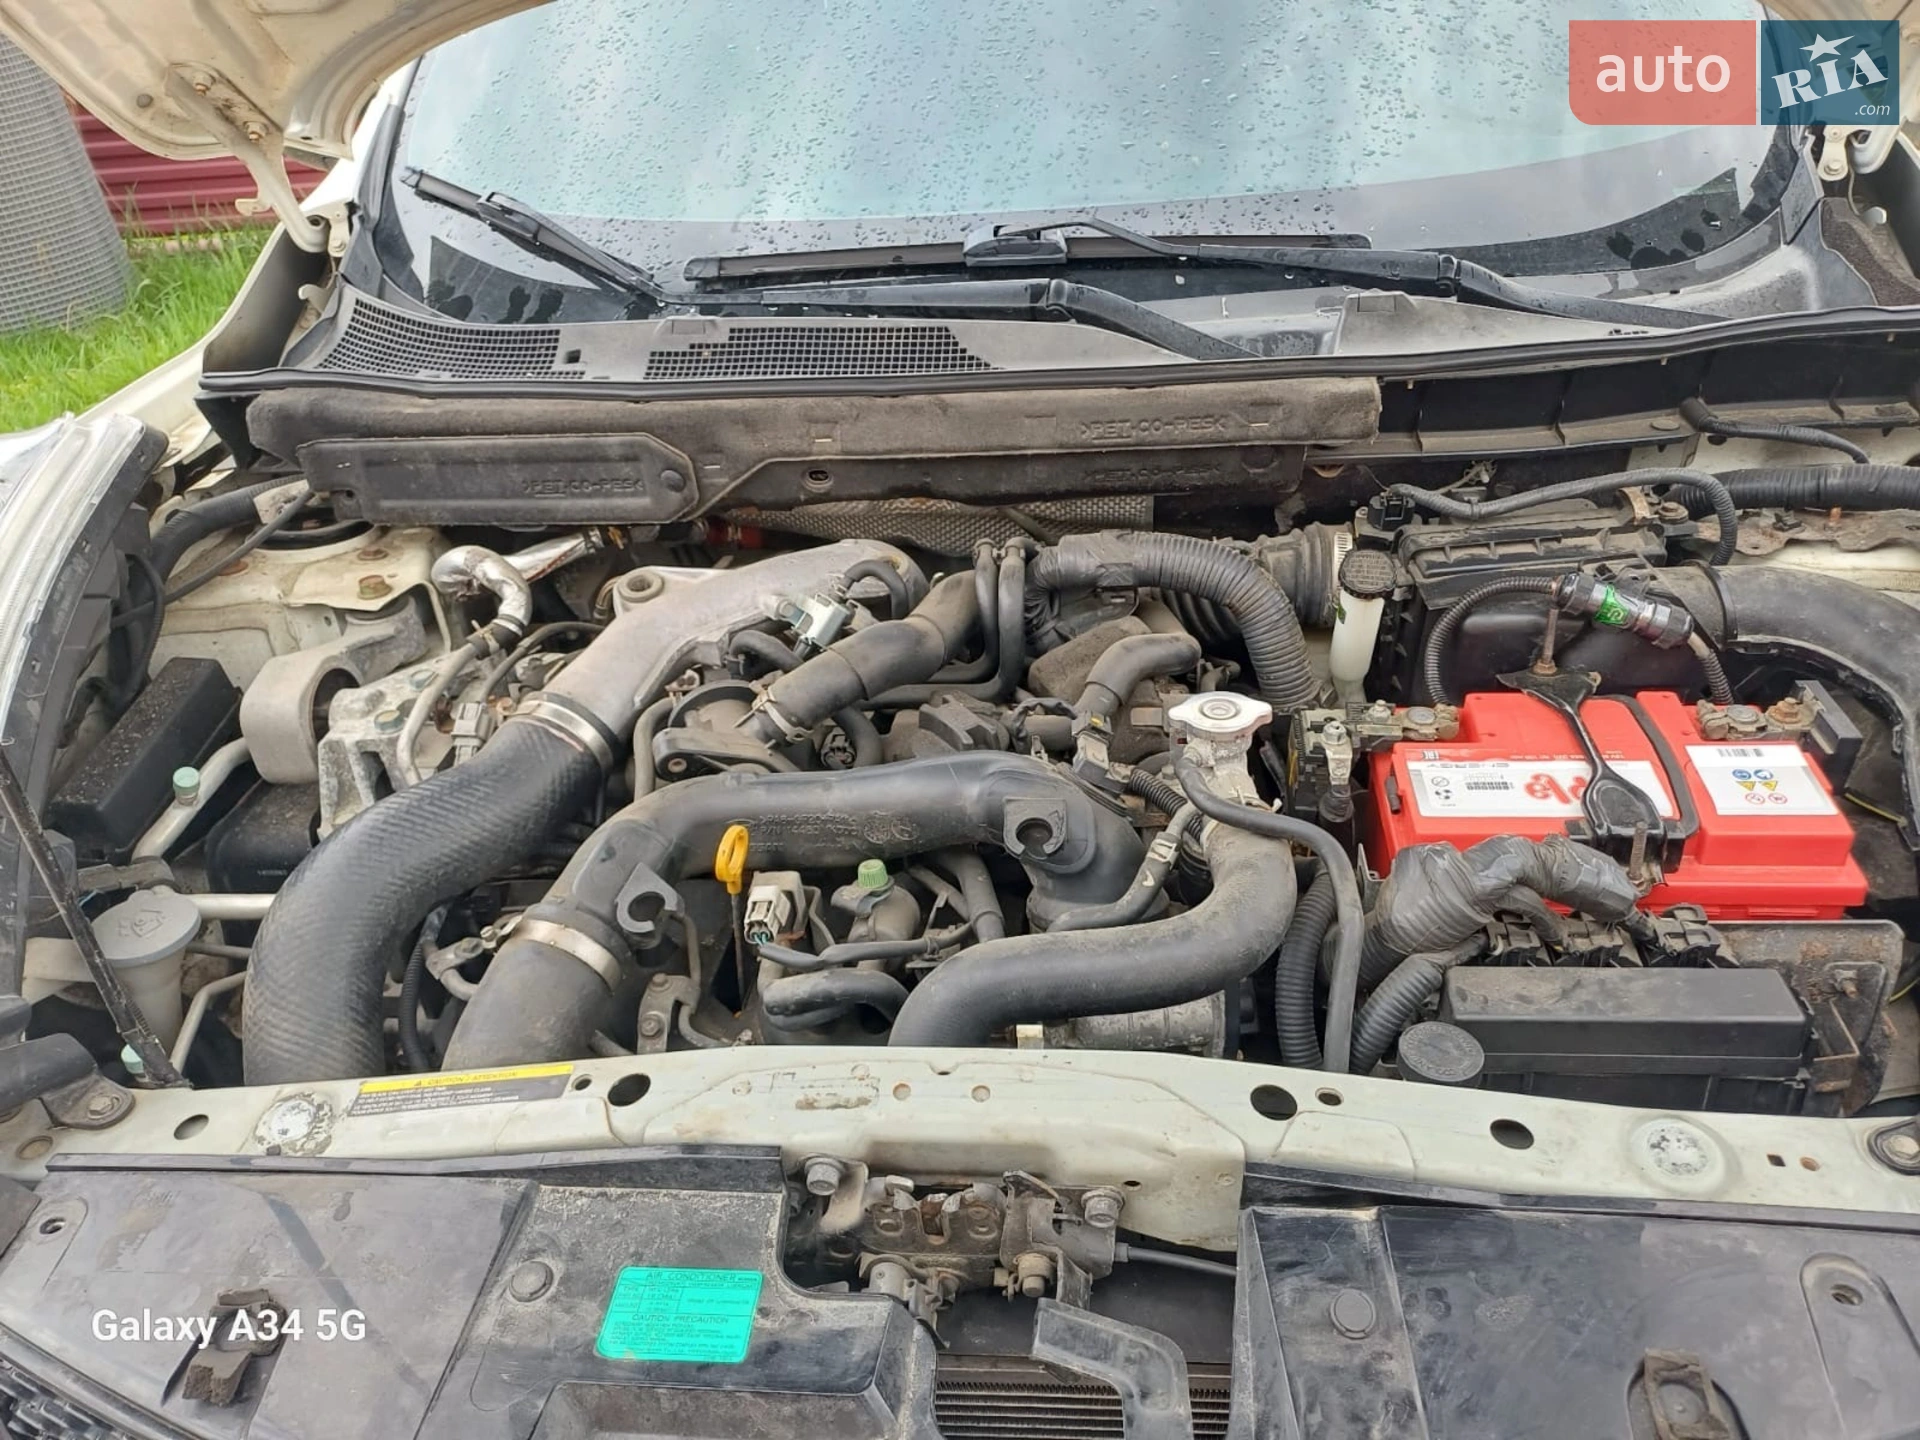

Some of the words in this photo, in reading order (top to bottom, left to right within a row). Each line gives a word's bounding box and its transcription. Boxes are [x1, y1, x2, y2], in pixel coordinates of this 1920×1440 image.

[646, 1271, 663, 1280] AIR
[667, 1272, 736, 1281] CONDITIONER
[632, 1313, 668, 1322] CAUTION
[674, 1315, 729, 1325] PRECAUTION
